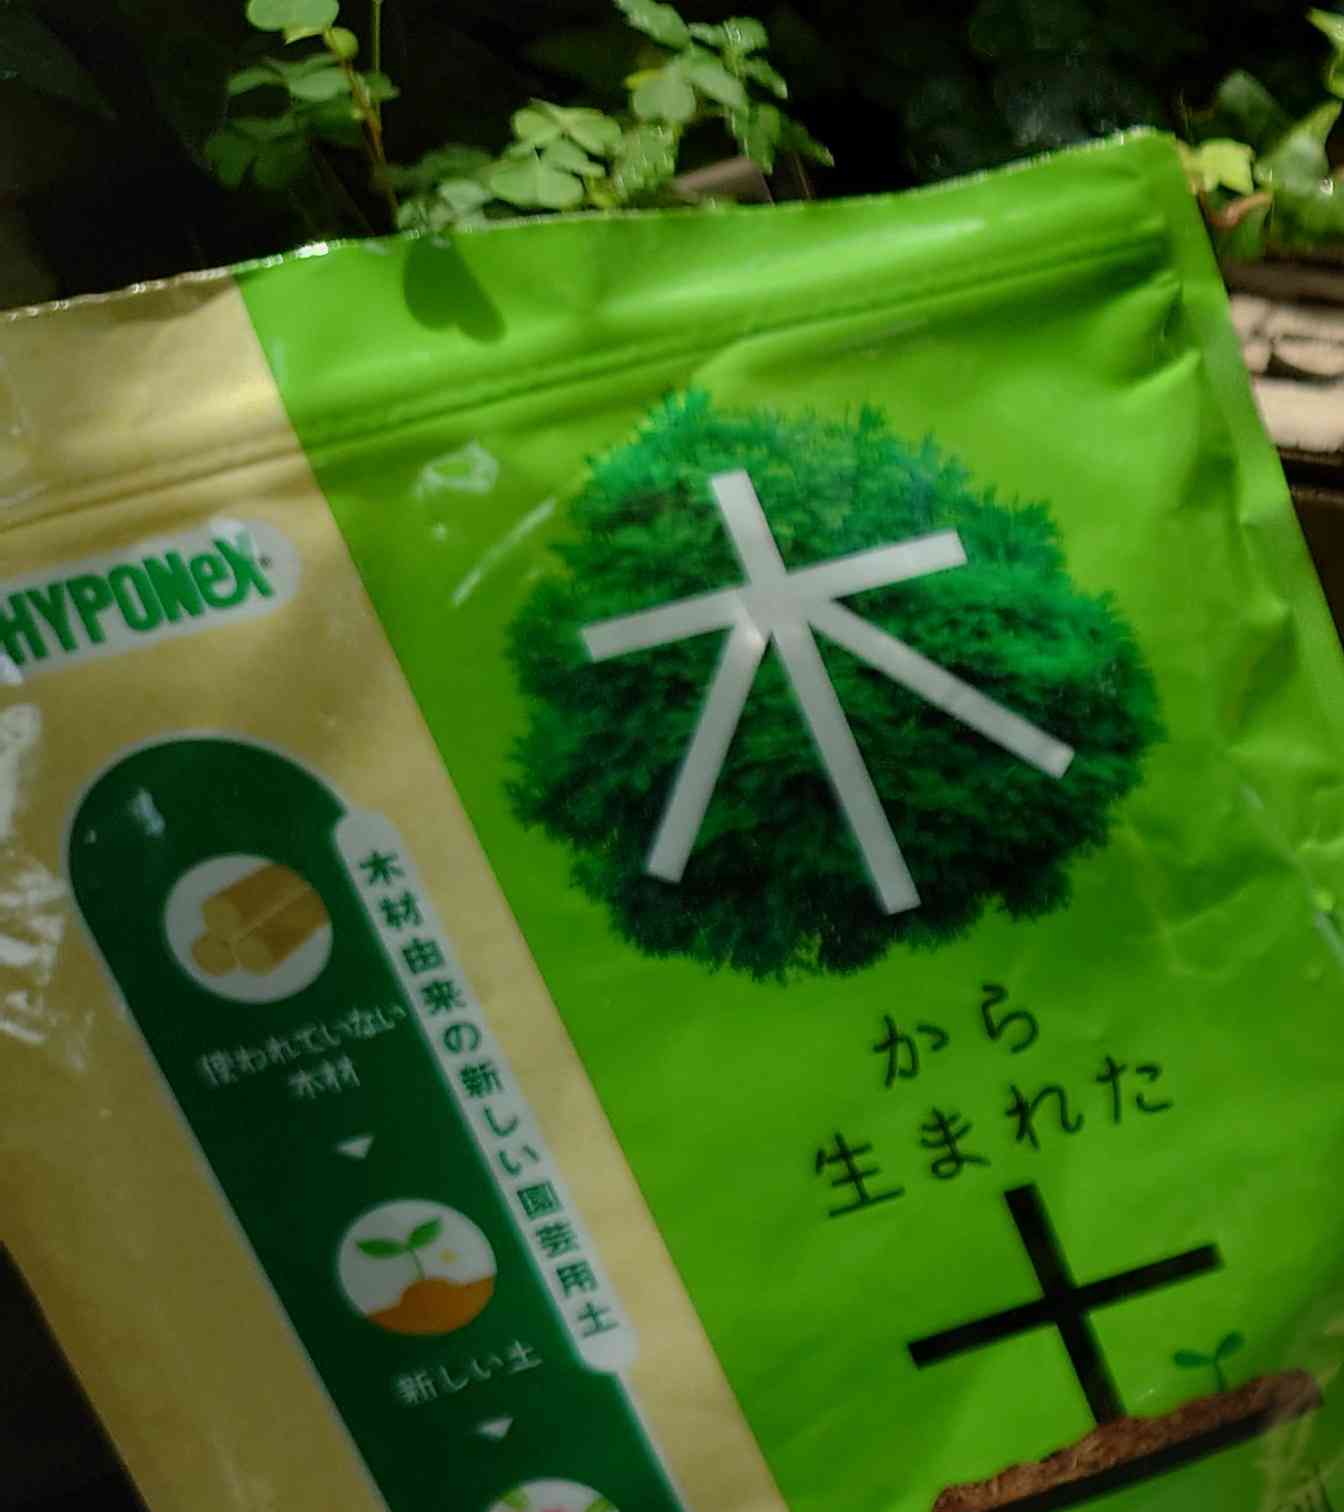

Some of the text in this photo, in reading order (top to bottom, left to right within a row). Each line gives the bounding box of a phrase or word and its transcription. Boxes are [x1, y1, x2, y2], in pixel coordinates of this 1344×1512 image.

[872, 984, 1040, 1091] から
[814, 1055, 1173, 1219] 生まれた
[397, 1338, 544, 1405] 新しい土
